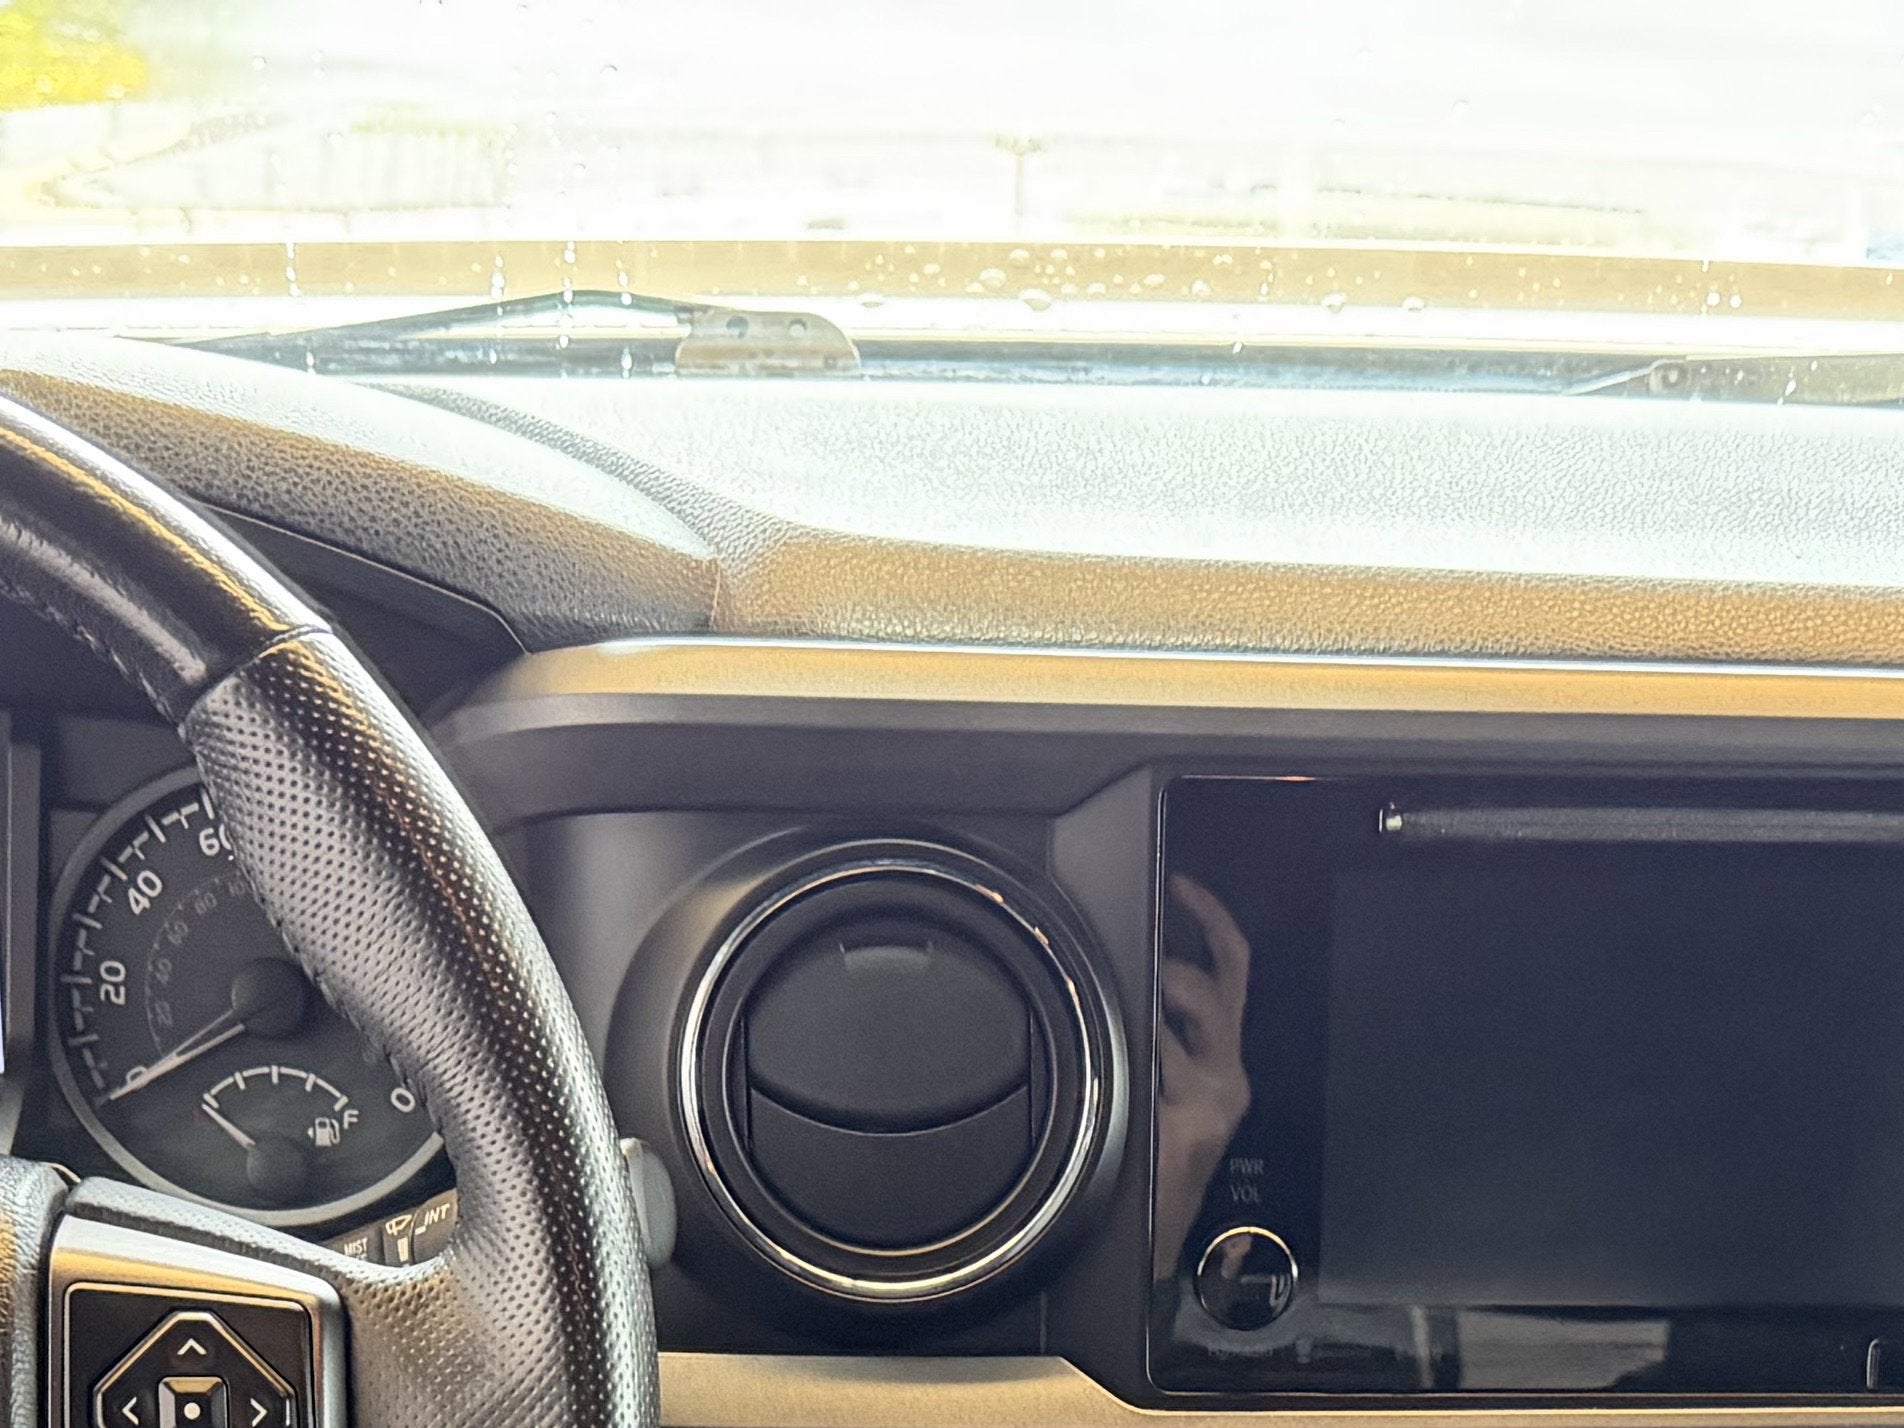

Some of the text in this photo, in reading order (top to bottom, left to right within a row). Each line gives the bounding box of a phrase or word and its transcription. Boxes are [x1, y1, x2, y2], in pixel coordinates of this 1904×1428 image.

[127, 869, 164, 916] 40
[99, 959, 127, 1007] 20
[343, 1108, 360, 1130] F
[424, 1203, 451, 1226] INT
[343, 1236, 369, 1256] MIST
